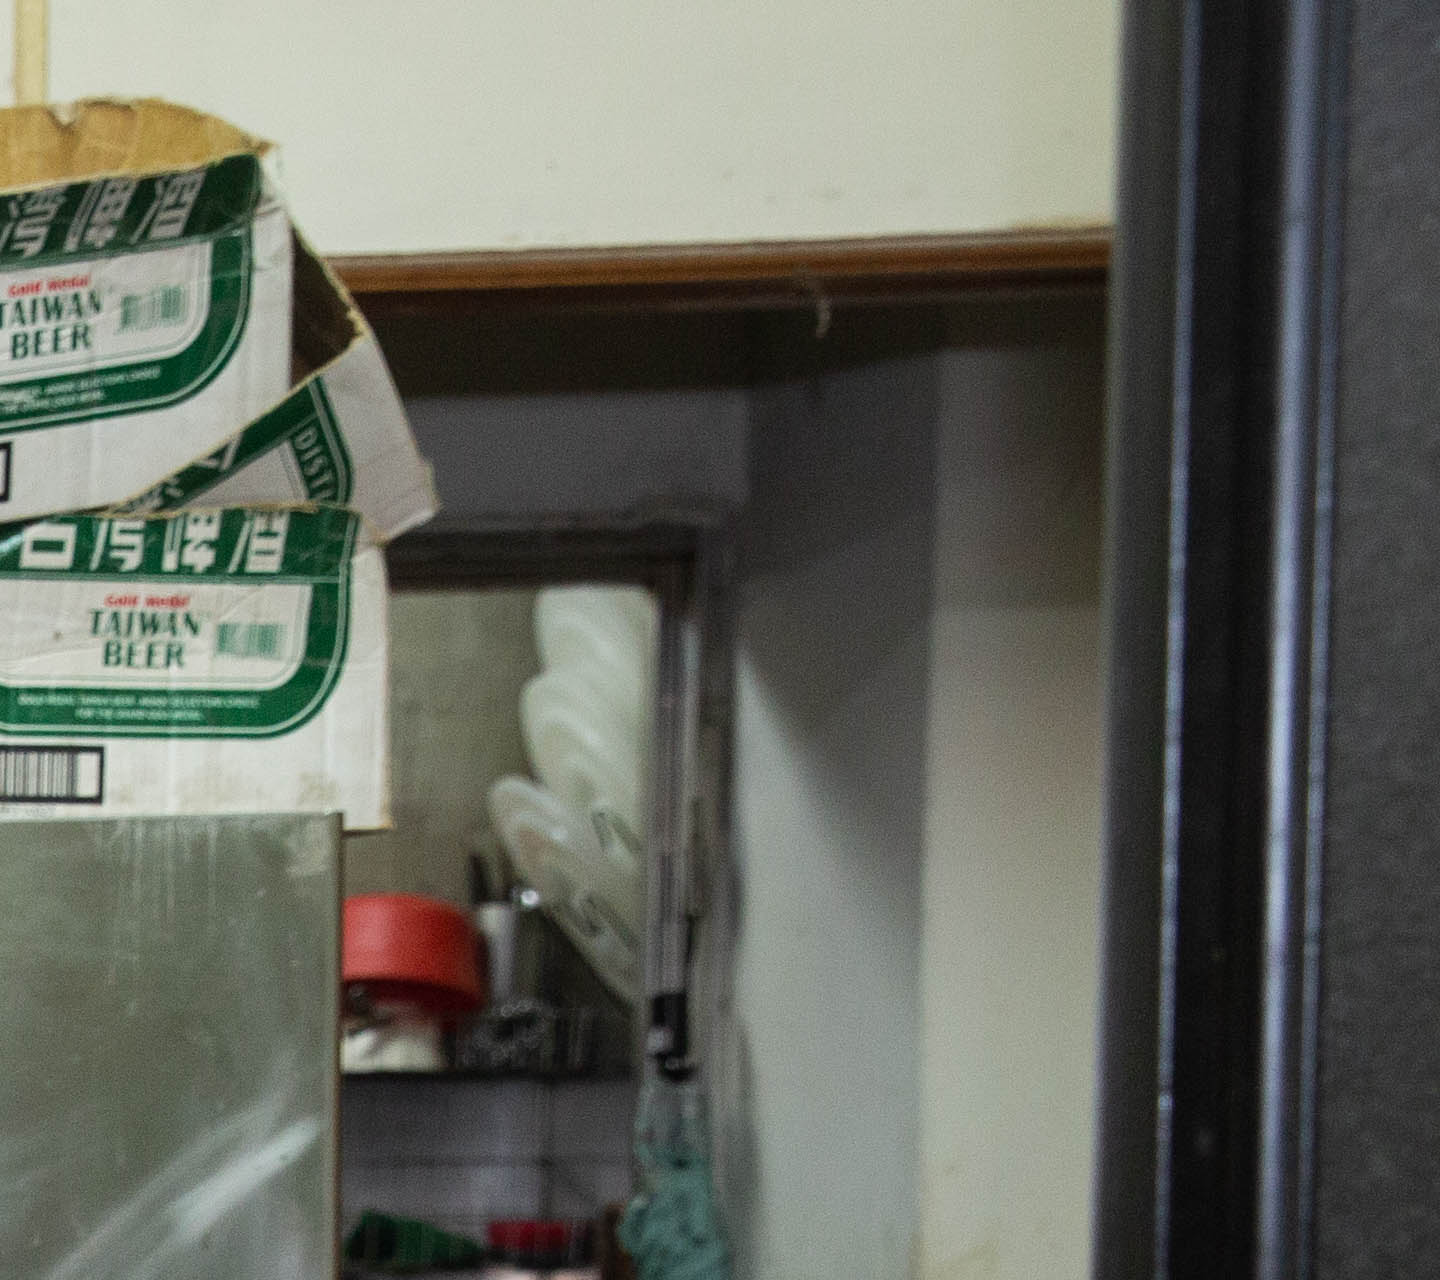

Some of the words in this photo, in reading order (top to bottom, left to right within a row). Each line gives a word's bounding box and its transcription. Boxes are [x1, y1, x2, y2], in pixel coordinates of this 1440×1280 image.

[10, 324, 92, 359] BEER
[88, 608, 201, 637] TAIWAN
[103, 640, 187, 669] BEER
